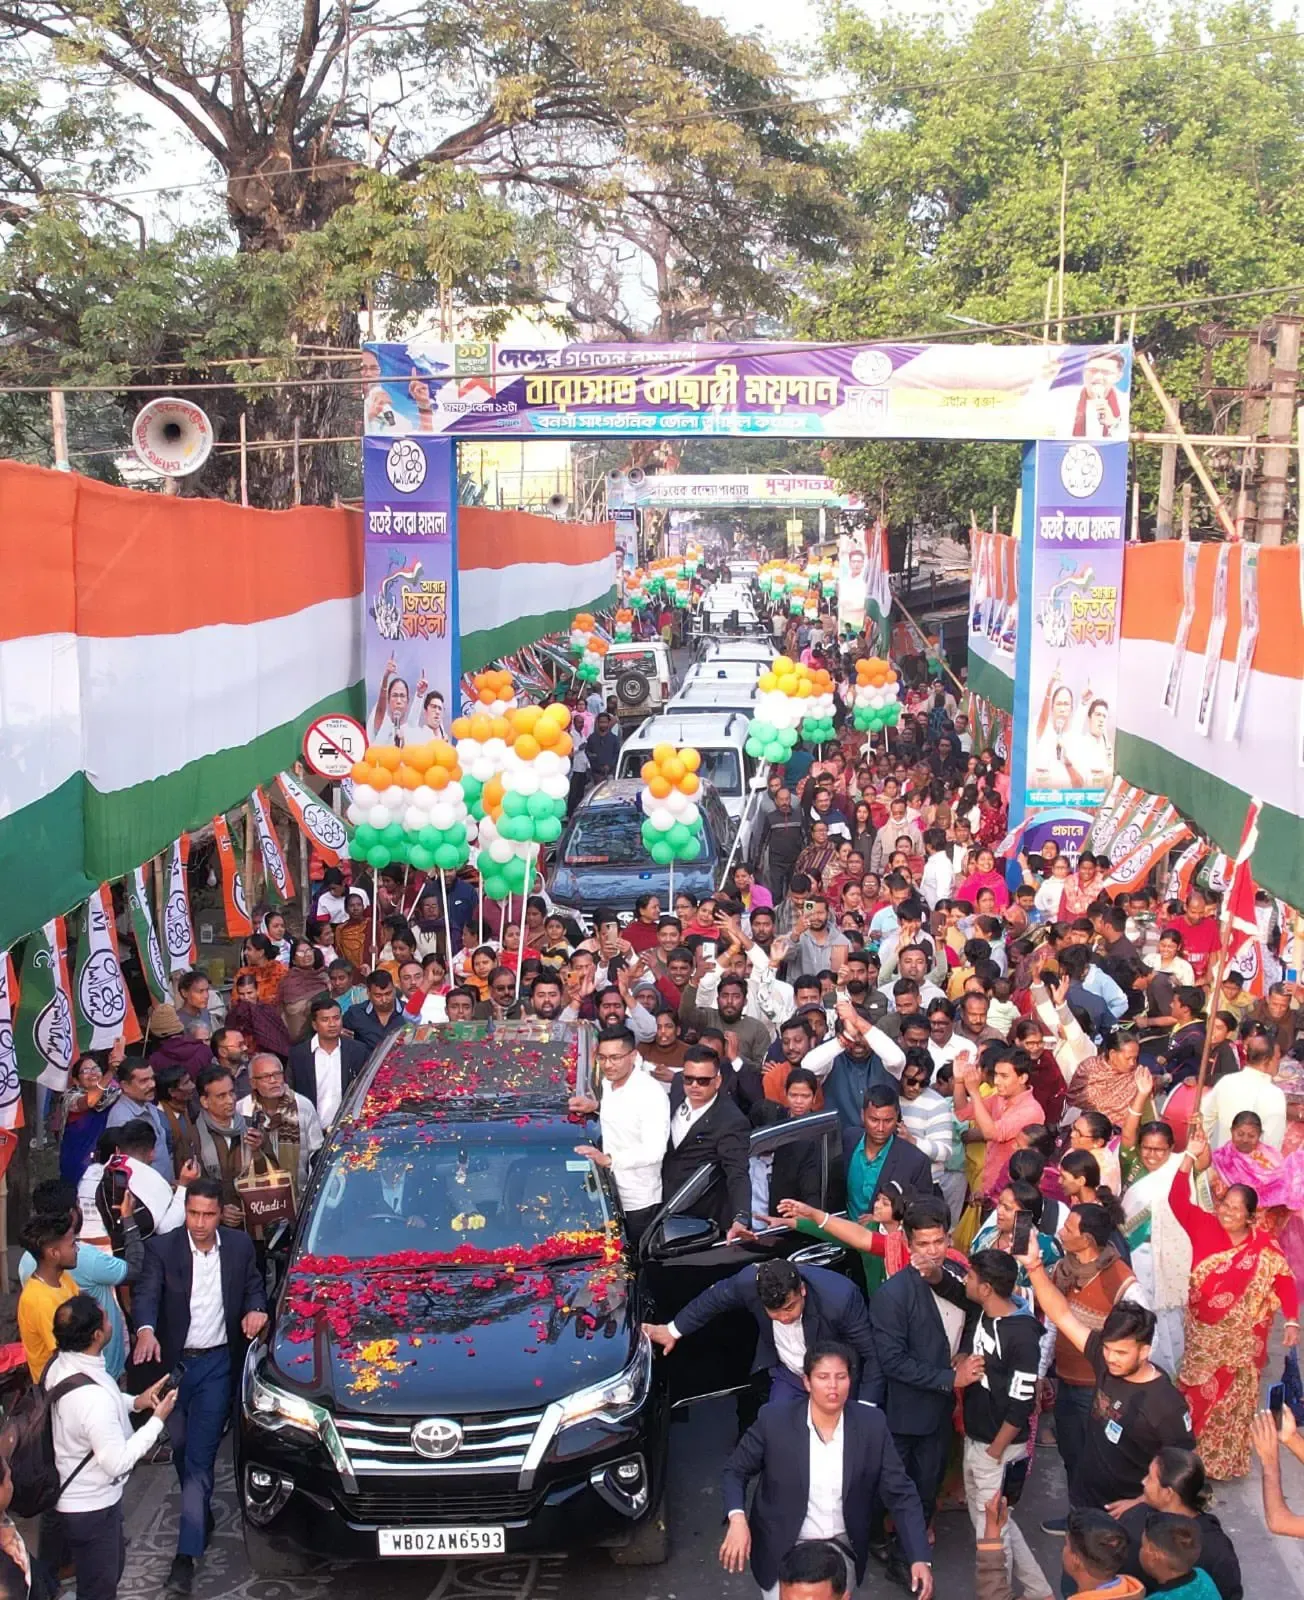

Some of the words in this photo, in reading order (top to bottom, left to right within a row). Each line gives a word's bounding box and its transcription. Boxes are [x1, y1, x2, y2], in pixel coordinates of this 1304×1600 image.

[524, 375, 638, 413] বারাসাত
[744, 375, 840, 414] ময়দান
[369, 505, 392, 536] যতই
[393, 512, 417, 536] করো
[418, 512, 447, 536] হামলা
[402, 585, 446, 613] জিতবে
[420, 580, 447, 593] আবার
[402, 613, 446, 640] বাংলা
